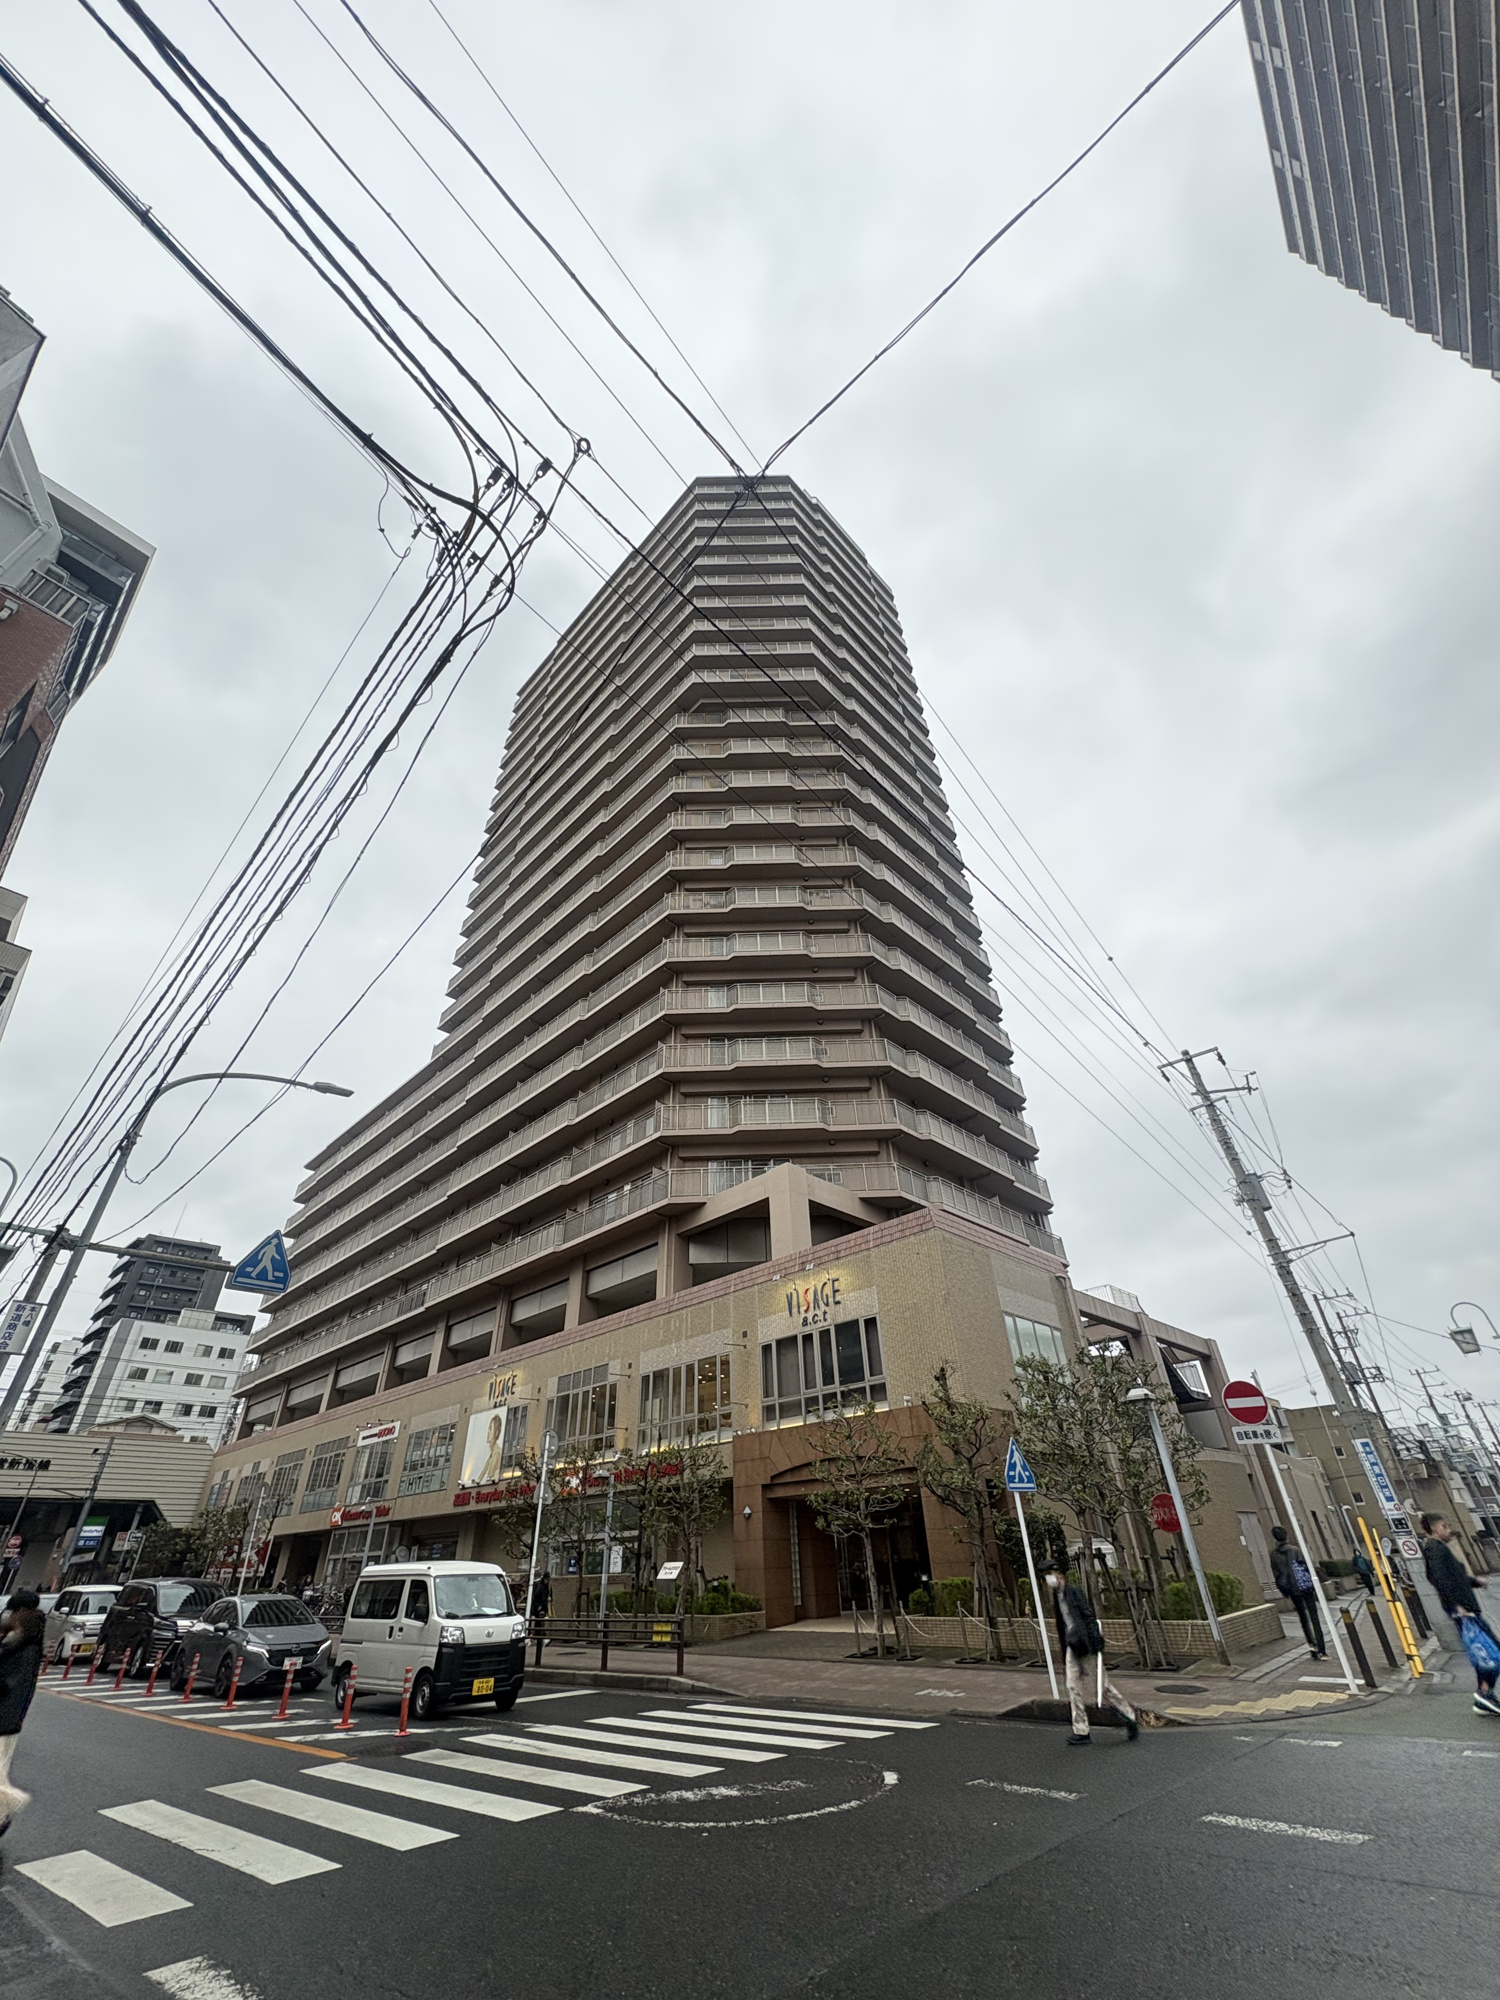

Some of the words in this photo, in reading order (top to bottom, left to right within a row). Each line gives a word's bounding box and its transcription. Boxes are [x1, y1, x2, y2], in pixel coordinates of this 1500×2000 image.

[786, 1278, 841, 1317] VISAGE
[801, 1309, 828, 1327] a.c.t
[488, 1375, 517, 1401] VISAGE
[1236, 1429, 1279, 1441] 自転車を除く
[332, 1506, 346, 1525] OK
